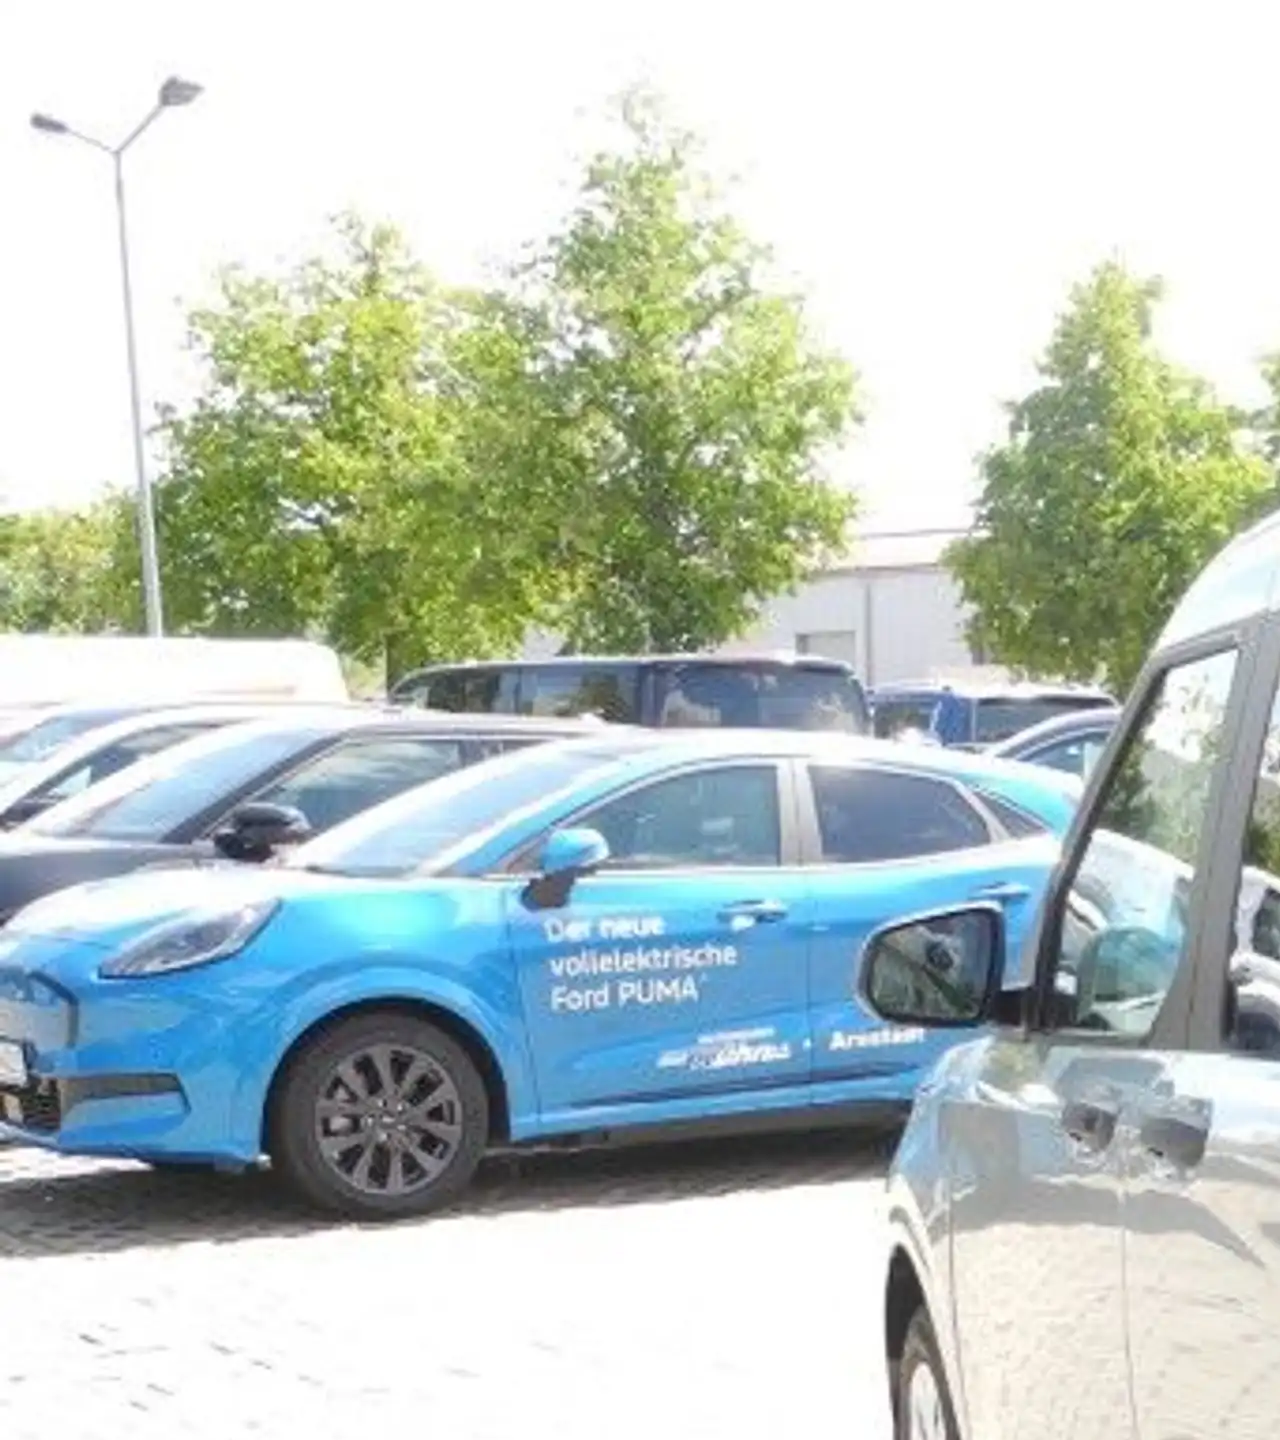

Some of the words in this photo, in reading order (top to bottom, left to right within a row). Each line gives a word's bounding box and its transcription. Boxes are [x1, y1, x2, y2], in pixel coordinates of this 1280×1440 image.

[543, 916, 591, 943] Der
[599, 915, 665, 939] neue
[549, 943, 738, 978] vollelektrische
[550, 982, 609, 1012] Ford
[618, 975, 699, 1010] PUMA
